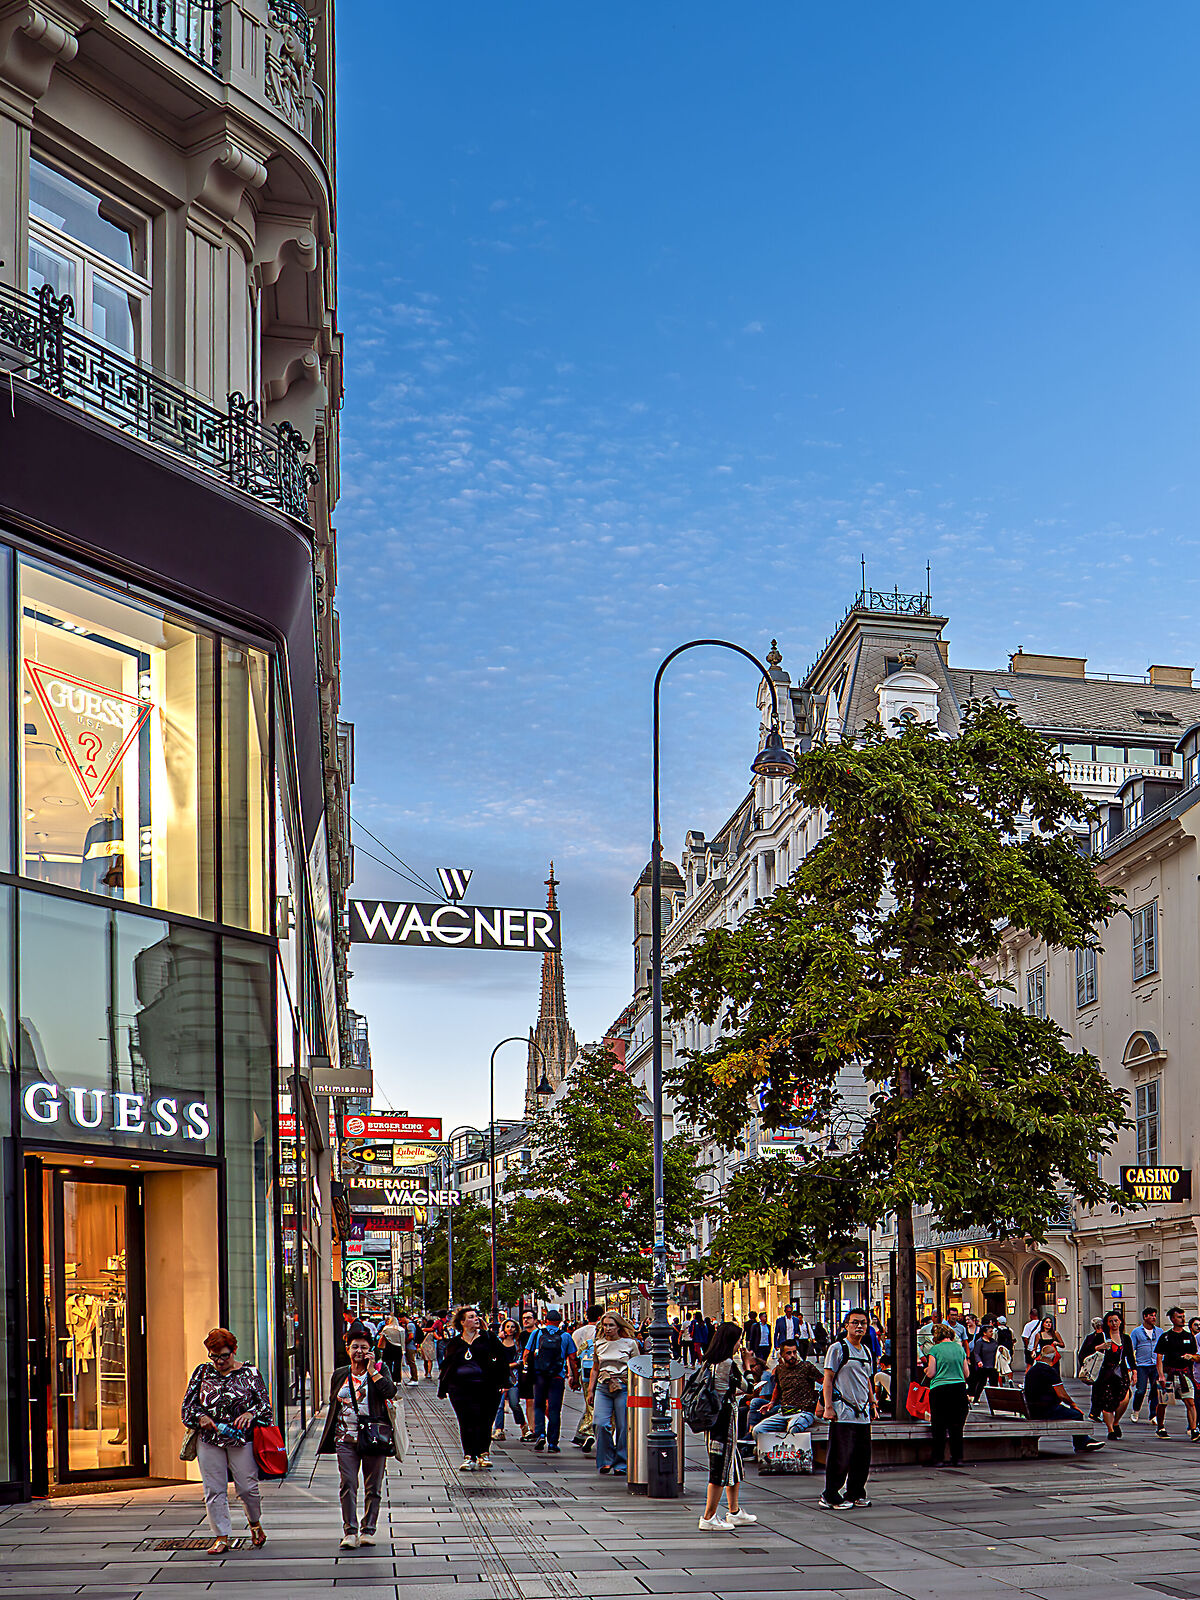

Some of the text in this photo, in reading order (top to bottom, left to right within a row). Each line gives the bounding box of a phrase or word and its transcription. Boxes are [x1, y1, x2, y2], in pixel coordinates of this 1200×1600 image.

[46, 680, 128, 729] GUESS
[354, 901, 555, 948] WAGNER
[314, 1085, 371, 1094] intimissimi
[23, 1082, 210, 1140] GUESS
[349, 1177, 420, 1190] LÄDERACH
[1126, 1168, 1180, 1184] CASINO
[384, 1189, 461, 1206] WAGNER
[1134, 1185, 1172, 1200] WIEN
[960, 1260, 989, 1279] WIEN
[767, 1450, 801, 1459] GUESS
